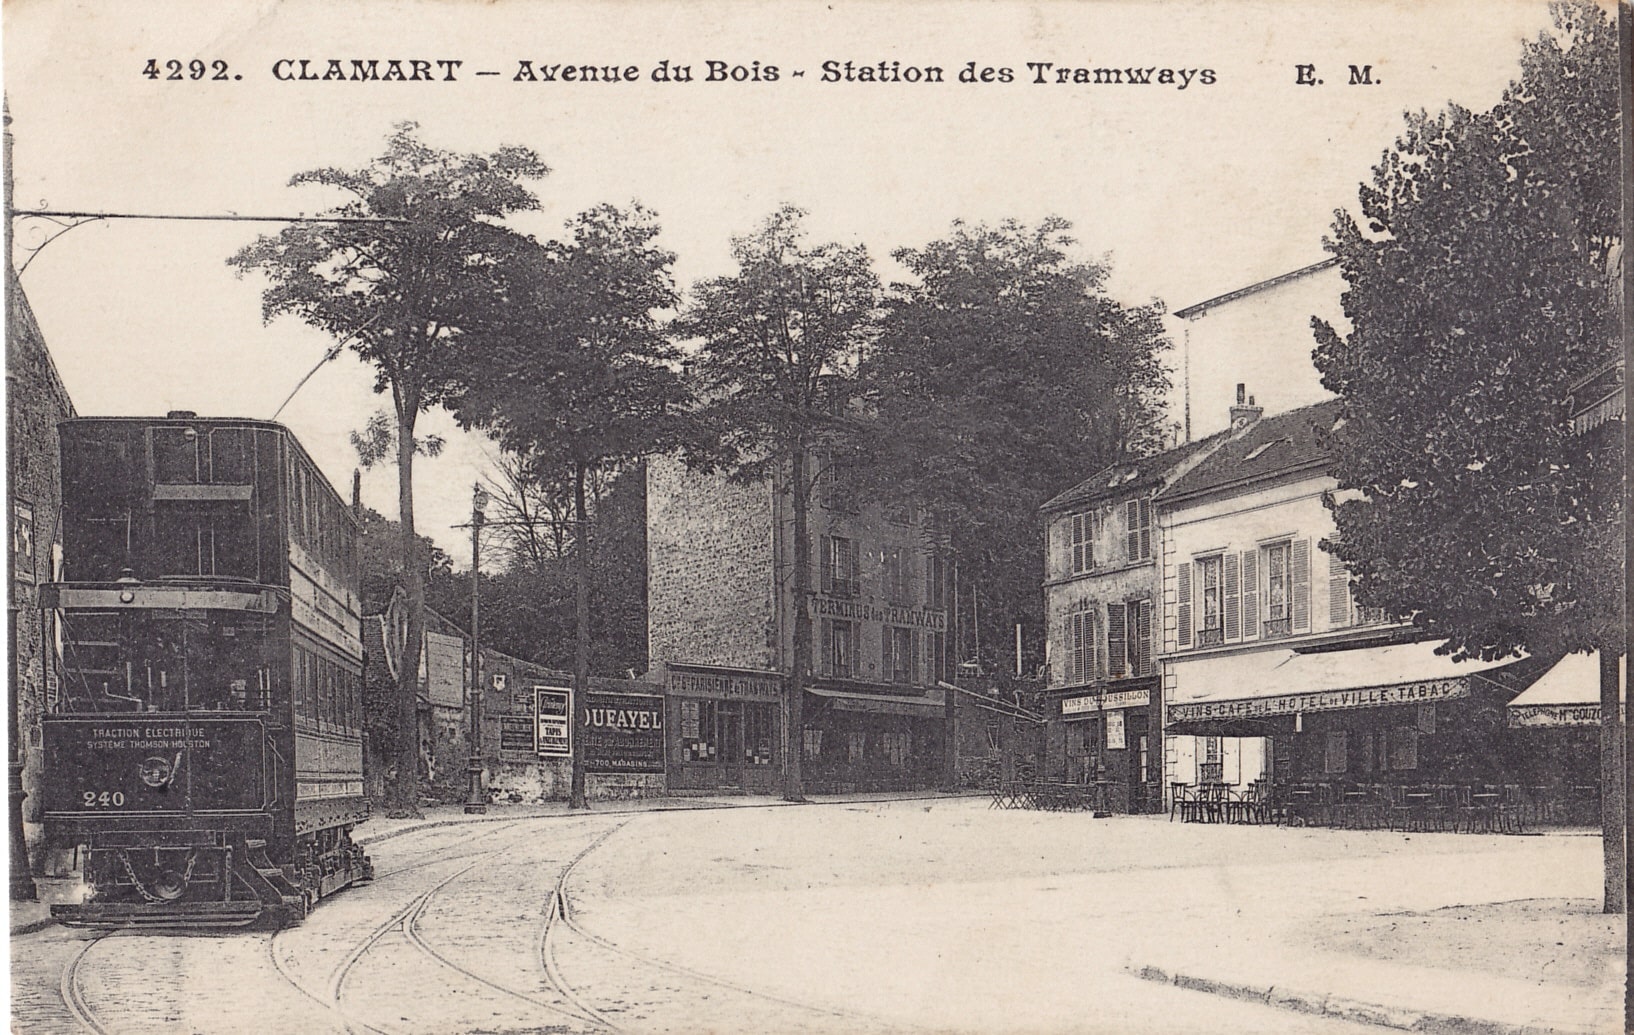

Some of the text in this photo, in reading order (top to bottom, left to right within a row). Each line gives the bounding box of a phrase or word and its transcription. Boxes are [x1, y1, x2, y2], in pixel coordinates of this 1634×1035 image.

[811, 597, 870, 620] TERMINUS
[884, 606, 945, 629] TRAMWAYS
[1397, 682, 1451, 700] TABAC
[1064, 691, 1149, 708] VINS DU OUSSILLON
[93, 728, 139, 738] TRACTION
[545, 727, 562, 736] TAPIS
[83, 791, 125, 807] 240
